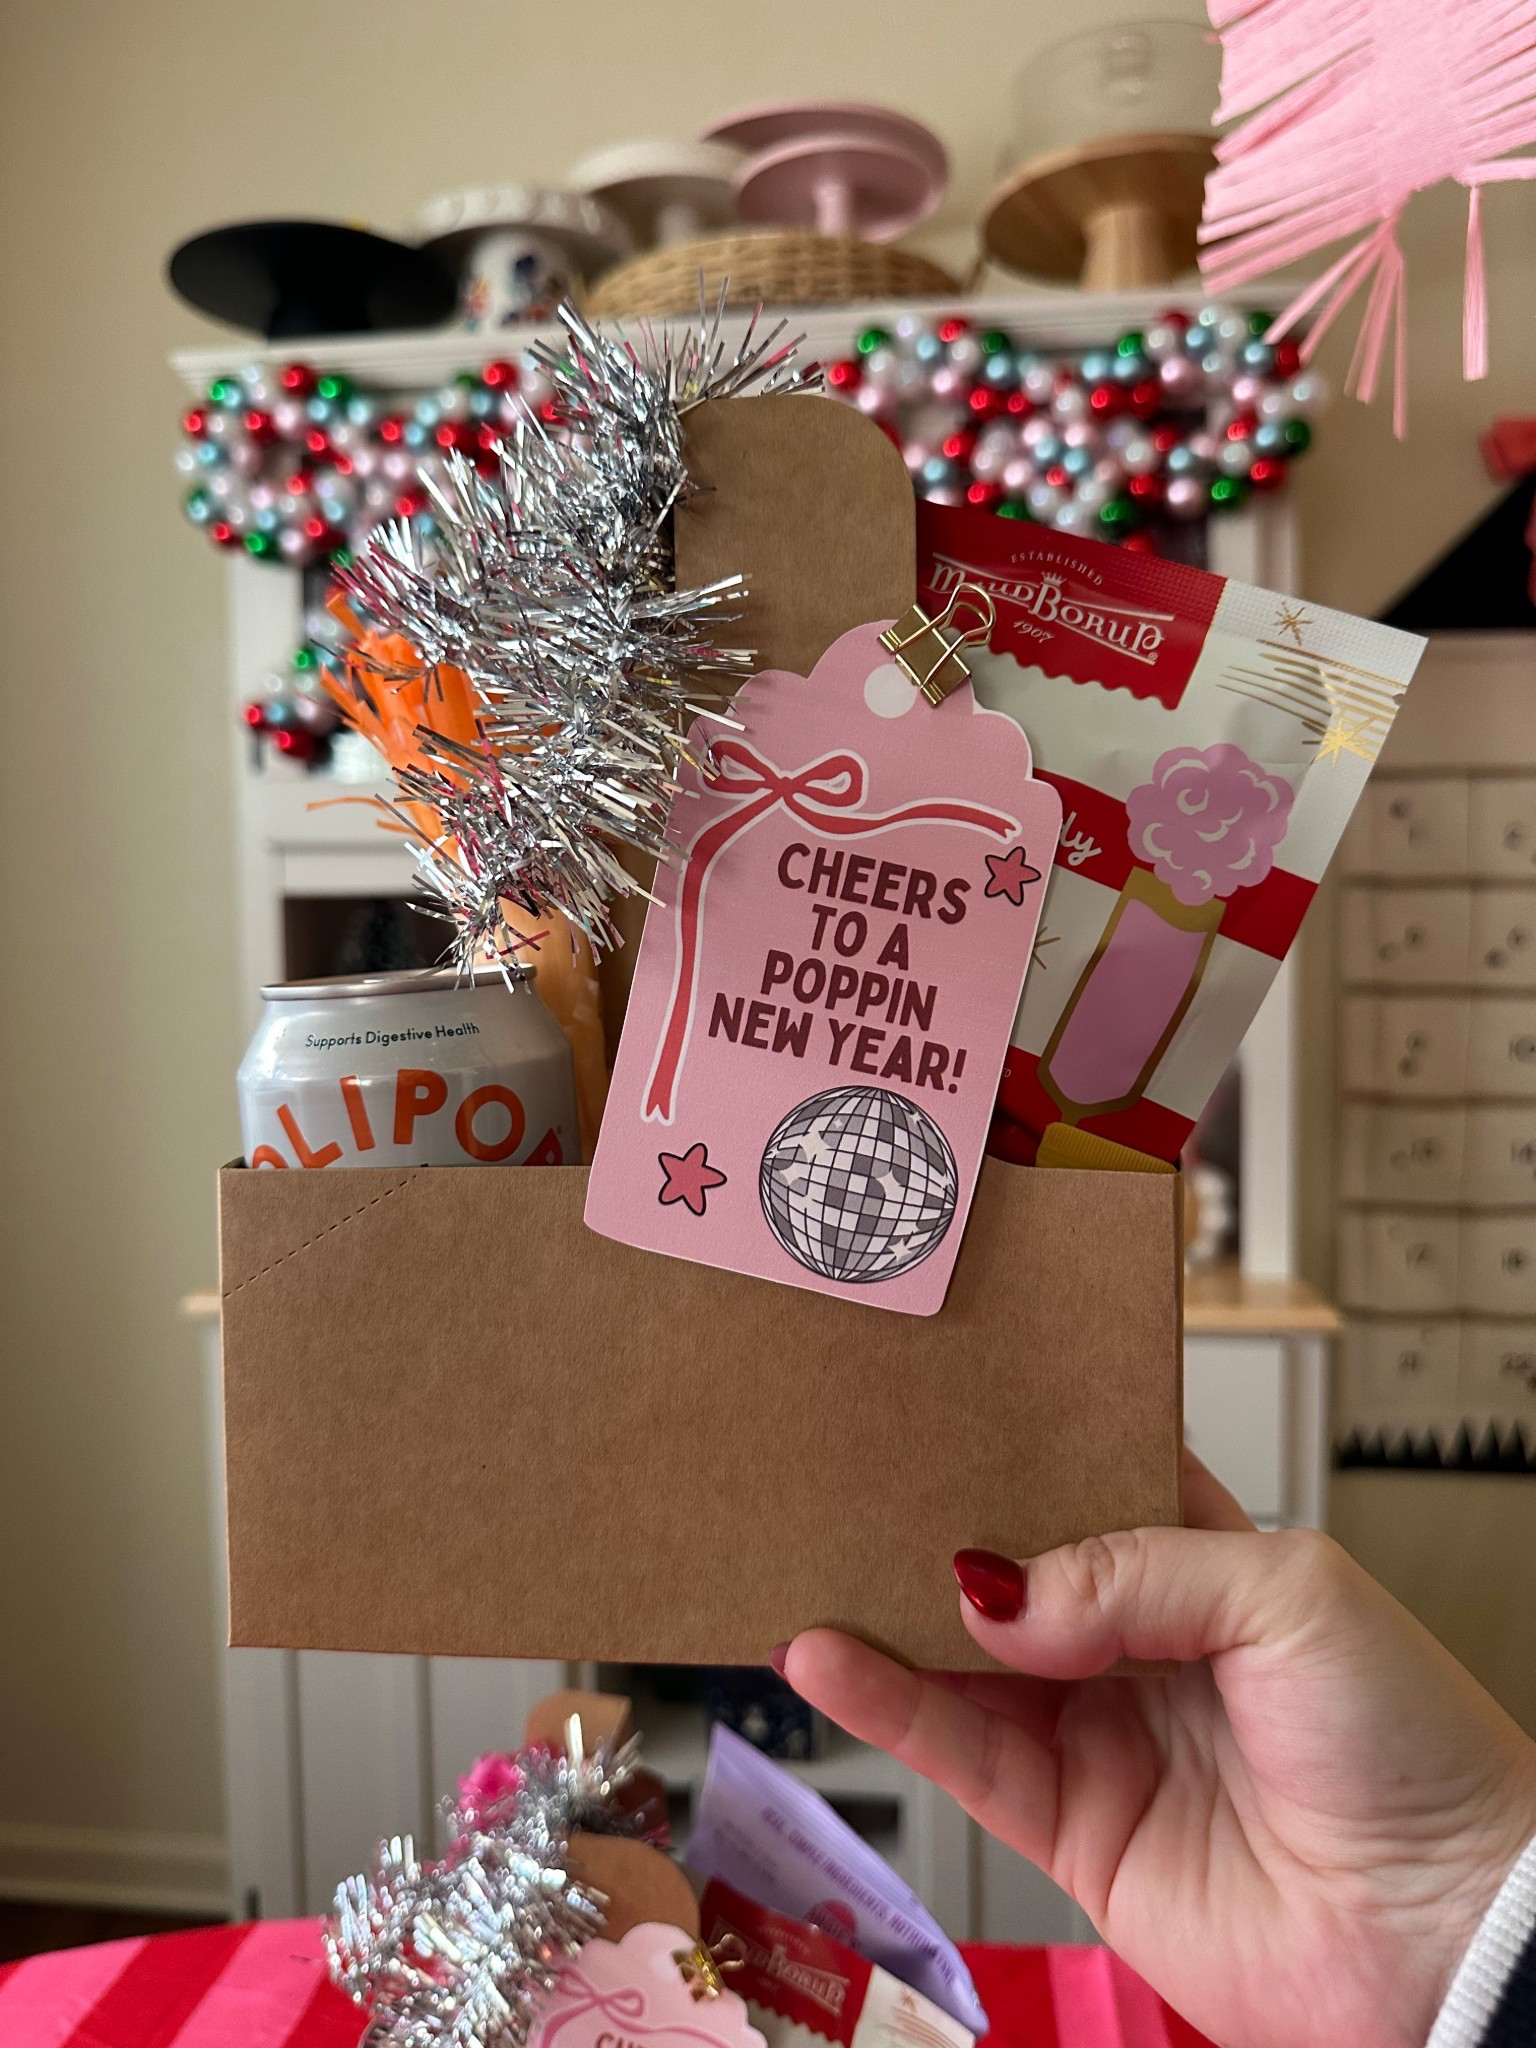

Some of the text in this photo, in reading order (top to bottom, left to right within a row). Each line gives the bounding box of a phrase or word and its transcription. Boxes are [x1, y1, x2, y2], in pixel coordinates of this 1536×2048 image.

[928, 562, 1035, 602] MUD
[1011, 550, 1103, 586] ESTABLISHED
[1013, 620, 1055, 644] 1907
[777, 842, 971, 925] CHEERS
[811, 903, 909, 971] TO A
[760, 949, 938, 1031] POPPIN
[305, 1022, 481, 1050] Supports Digestive Health
[708, 992, 967, 1094] NEW YEAR!
[252, 1068, 564, 1168] LIPO
